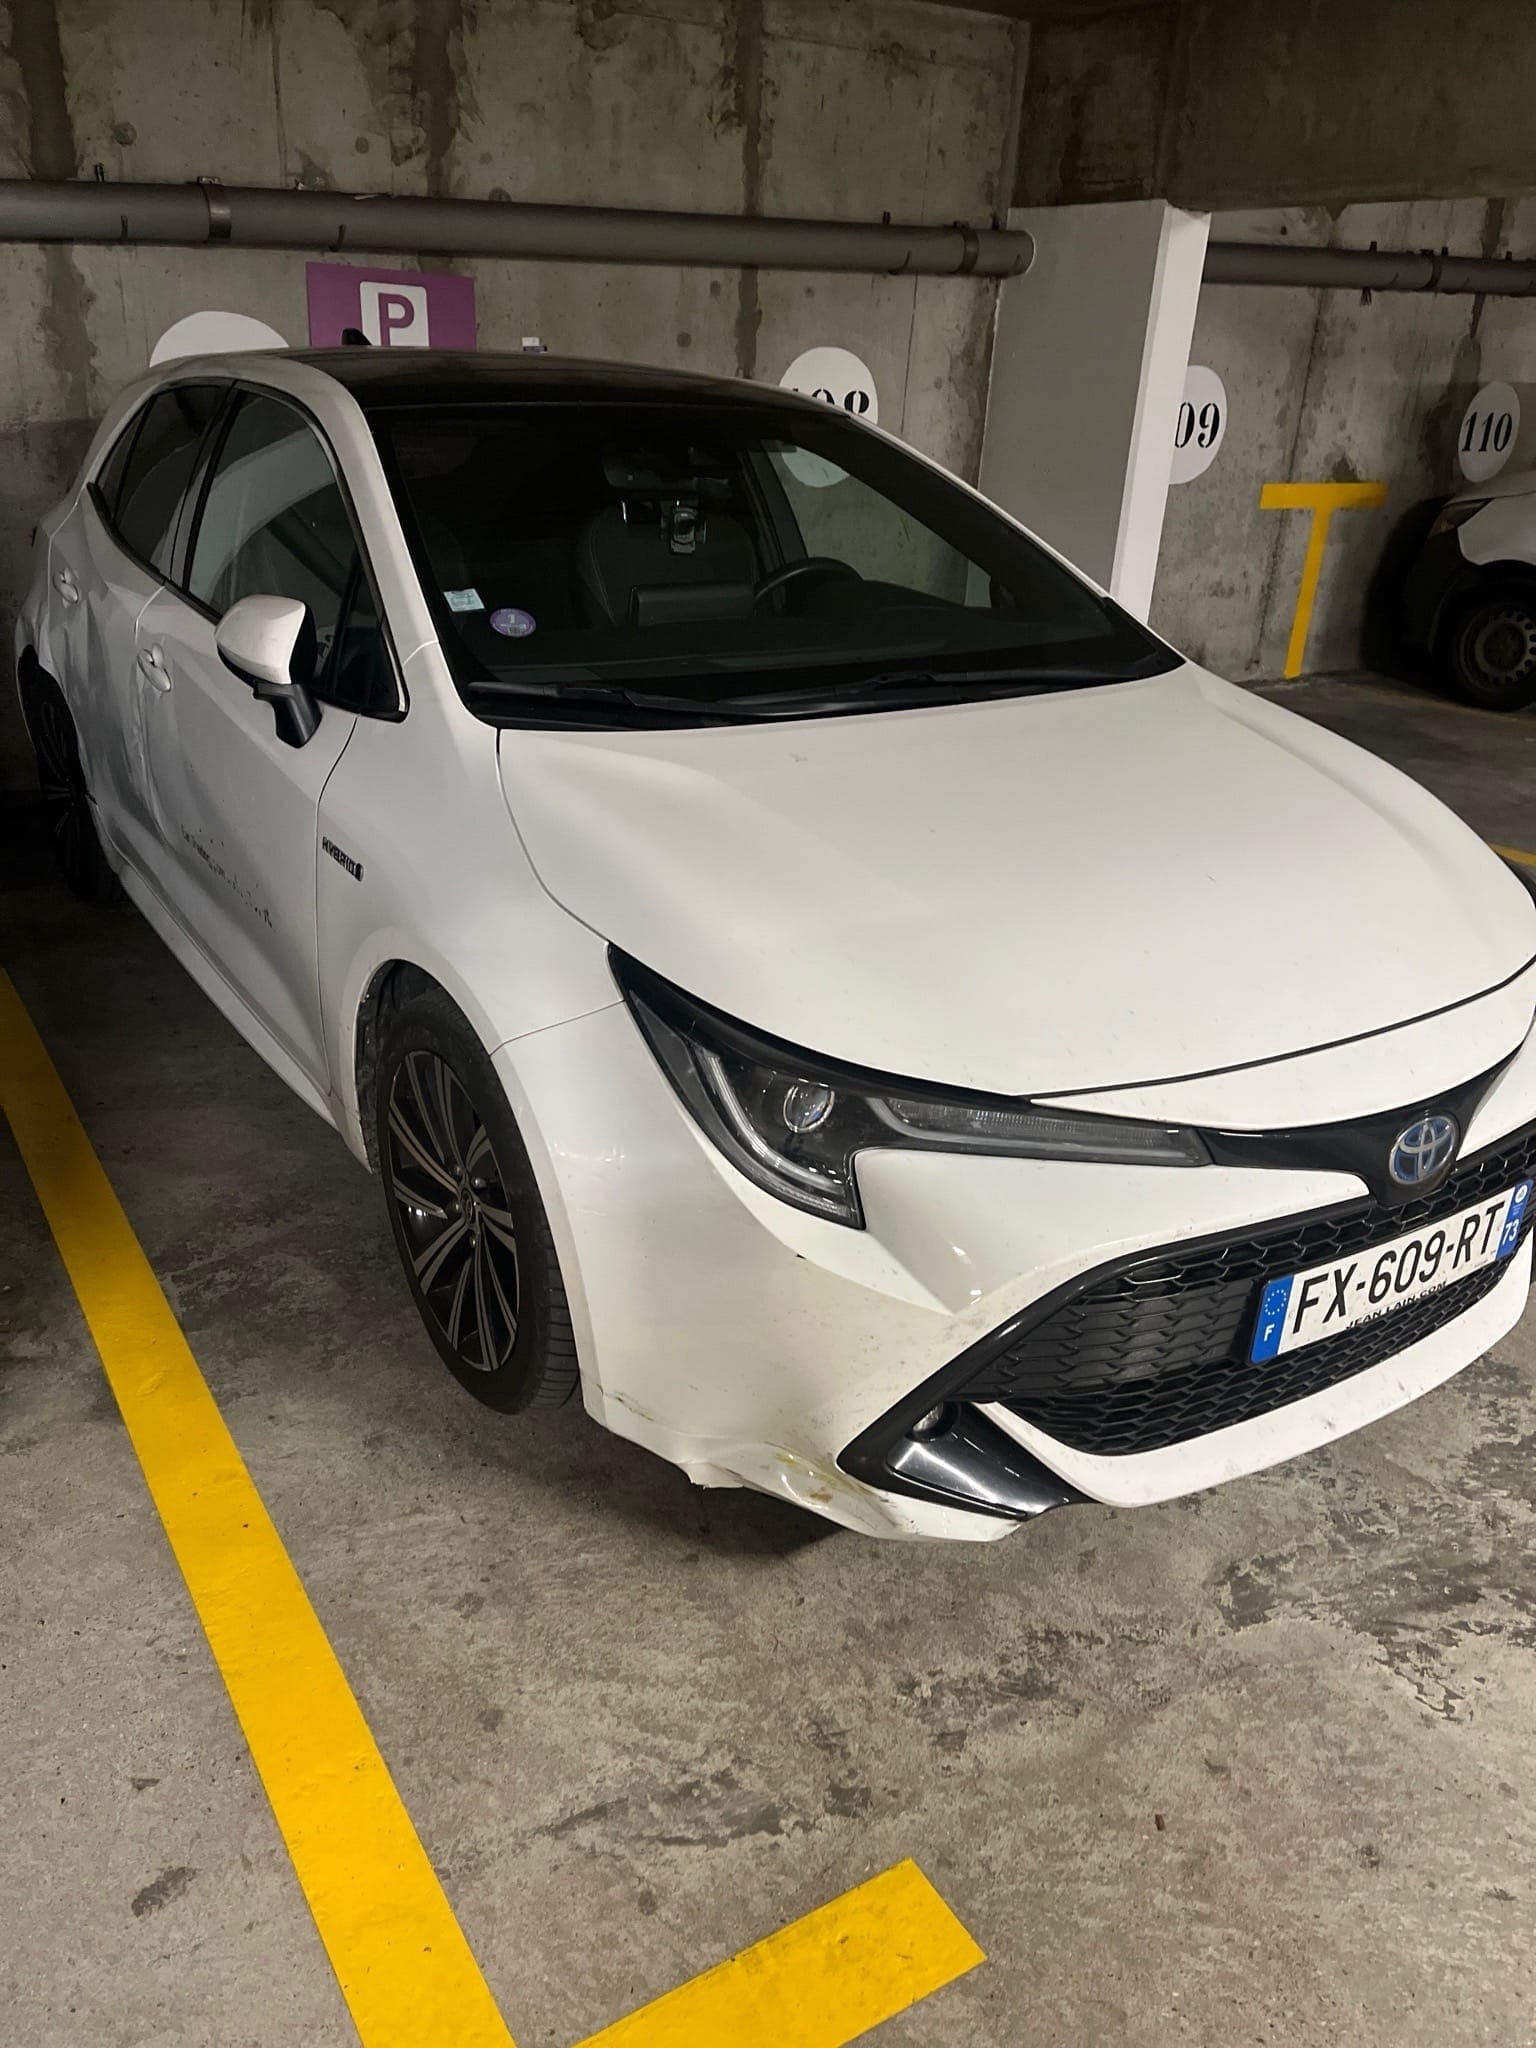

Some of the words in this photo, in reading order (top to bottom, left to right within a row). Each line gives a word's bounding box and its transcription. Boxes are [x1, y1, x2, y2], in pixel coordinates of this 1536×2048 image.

[378, 292, 414, 347] P
[1174, 401, 1220, 448] 09
[1461, 411, 1513, 452] 110
[321, 836, 356, 877] HYBRID
[1502, 1218, 1520, 1247] 73
[1293, 1200, 1505, 1335] FX-609-RT
[1263, 1323, 1275, 1342] F
